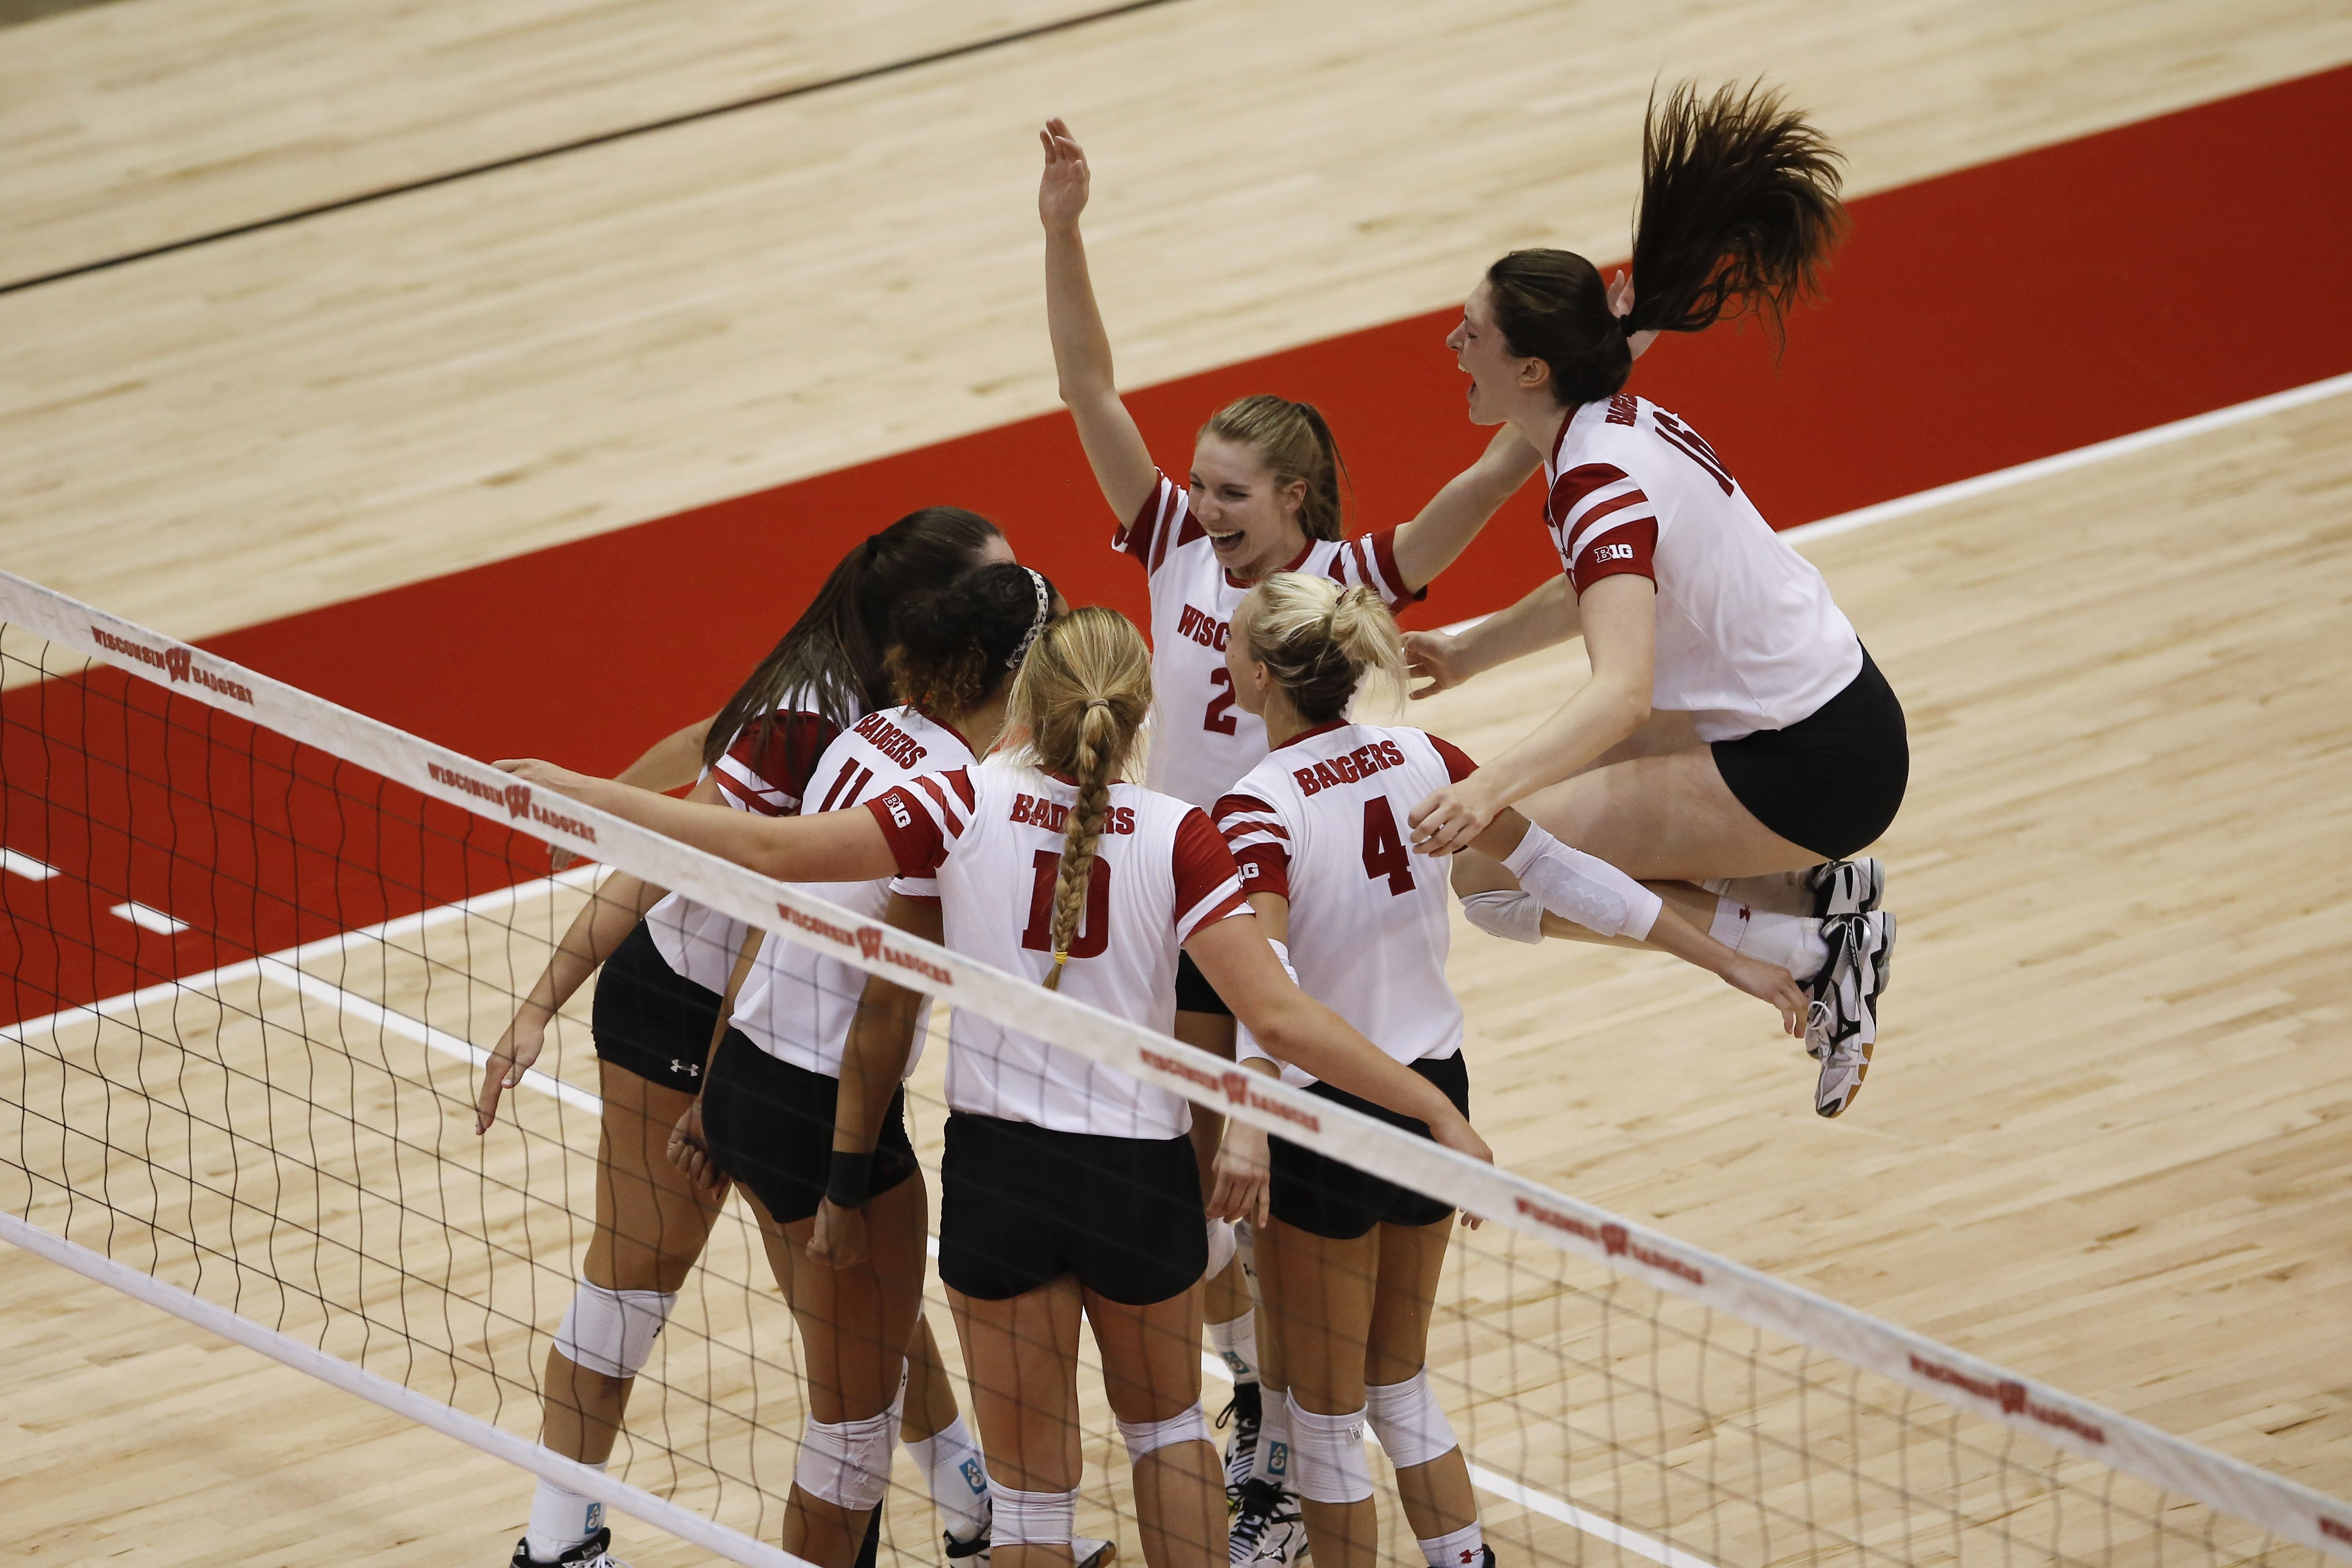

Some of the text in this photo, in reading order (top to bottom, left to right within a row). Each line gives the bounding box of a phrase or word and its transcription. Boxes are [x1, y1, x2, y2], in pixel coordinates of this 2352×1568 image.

[91, 625, 166, 670] WISCONSIN
[191, 666, 254, 706] BADGERS
[1204, 667, 1237, 736] 2
[853, 712, 927, 770] BADGERS
[818, 756, 874, 812] 11
[1010, 793, 1135, 834] BADRS
[1362, 795, 1416, 896] 4
[1022, 849, 1111, 959] 10
